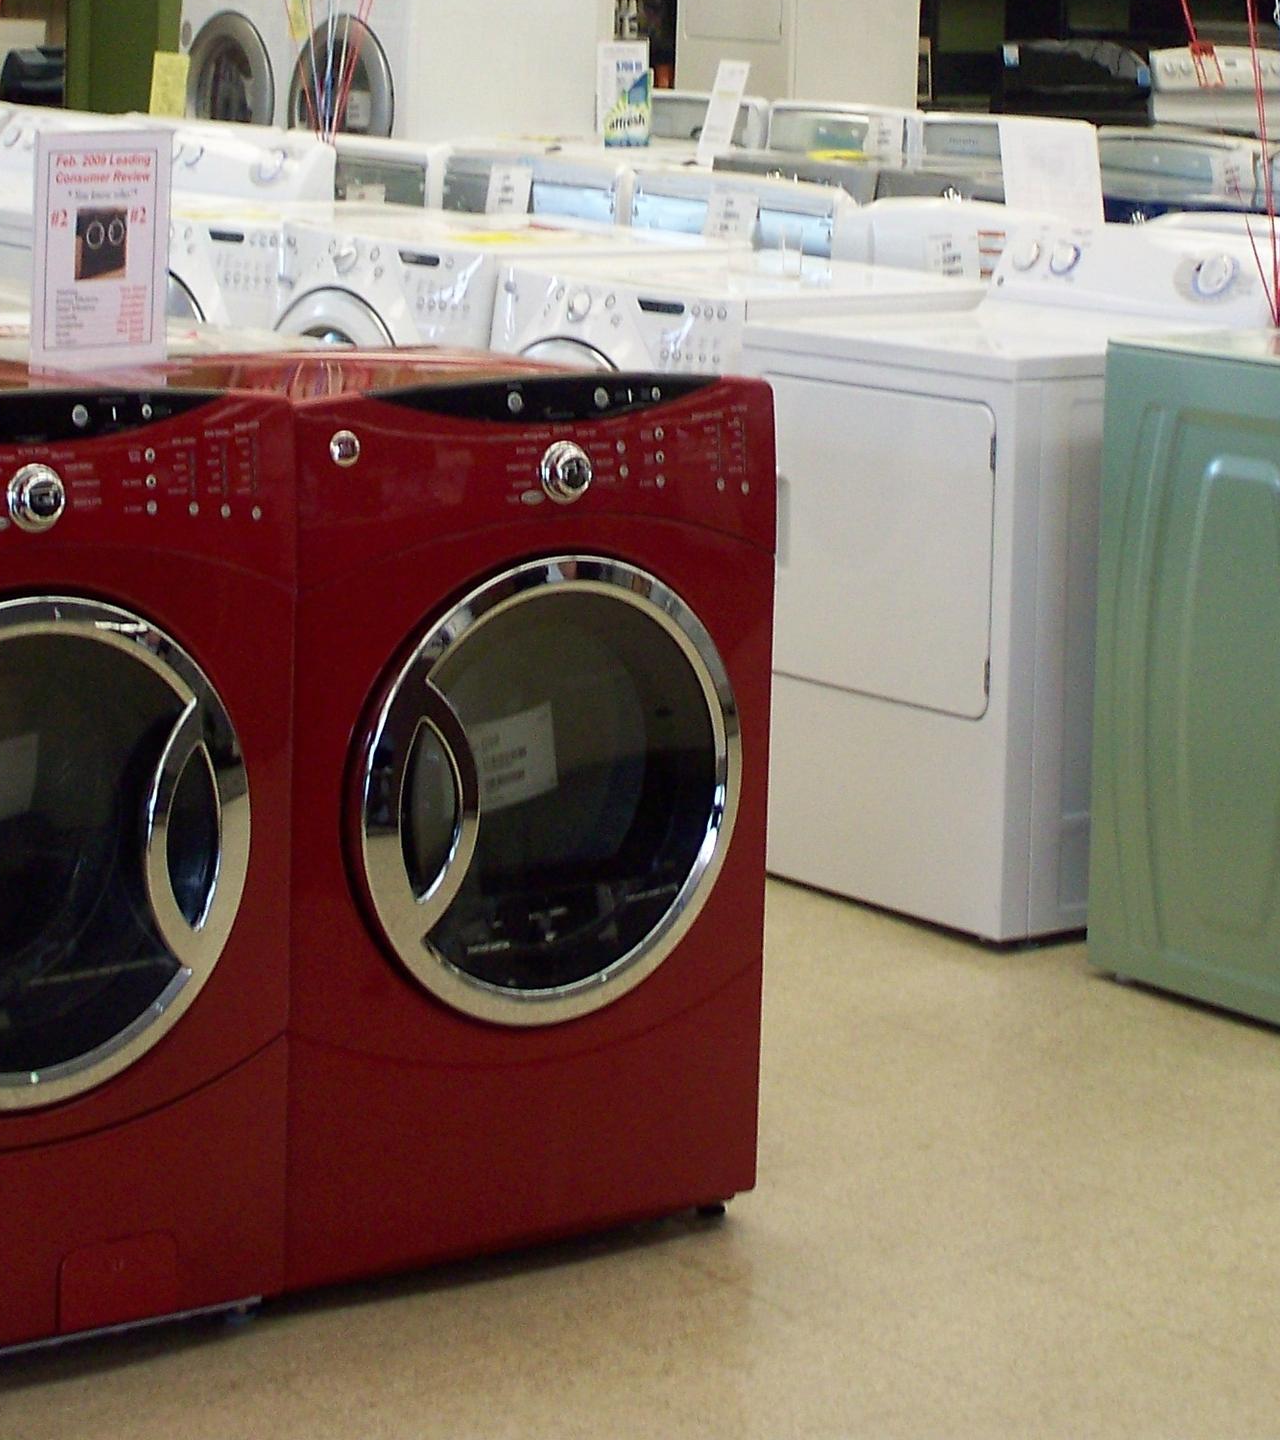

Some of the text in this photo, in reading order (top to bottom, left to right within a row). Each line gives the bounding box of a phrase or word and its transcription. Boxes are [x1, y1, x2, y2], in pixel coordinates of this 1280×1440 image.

[609, 113, 646, 131] affresh
[55, 169, 151, 184] Consumer Review
[50, 205, 147, 228] #2 #2
